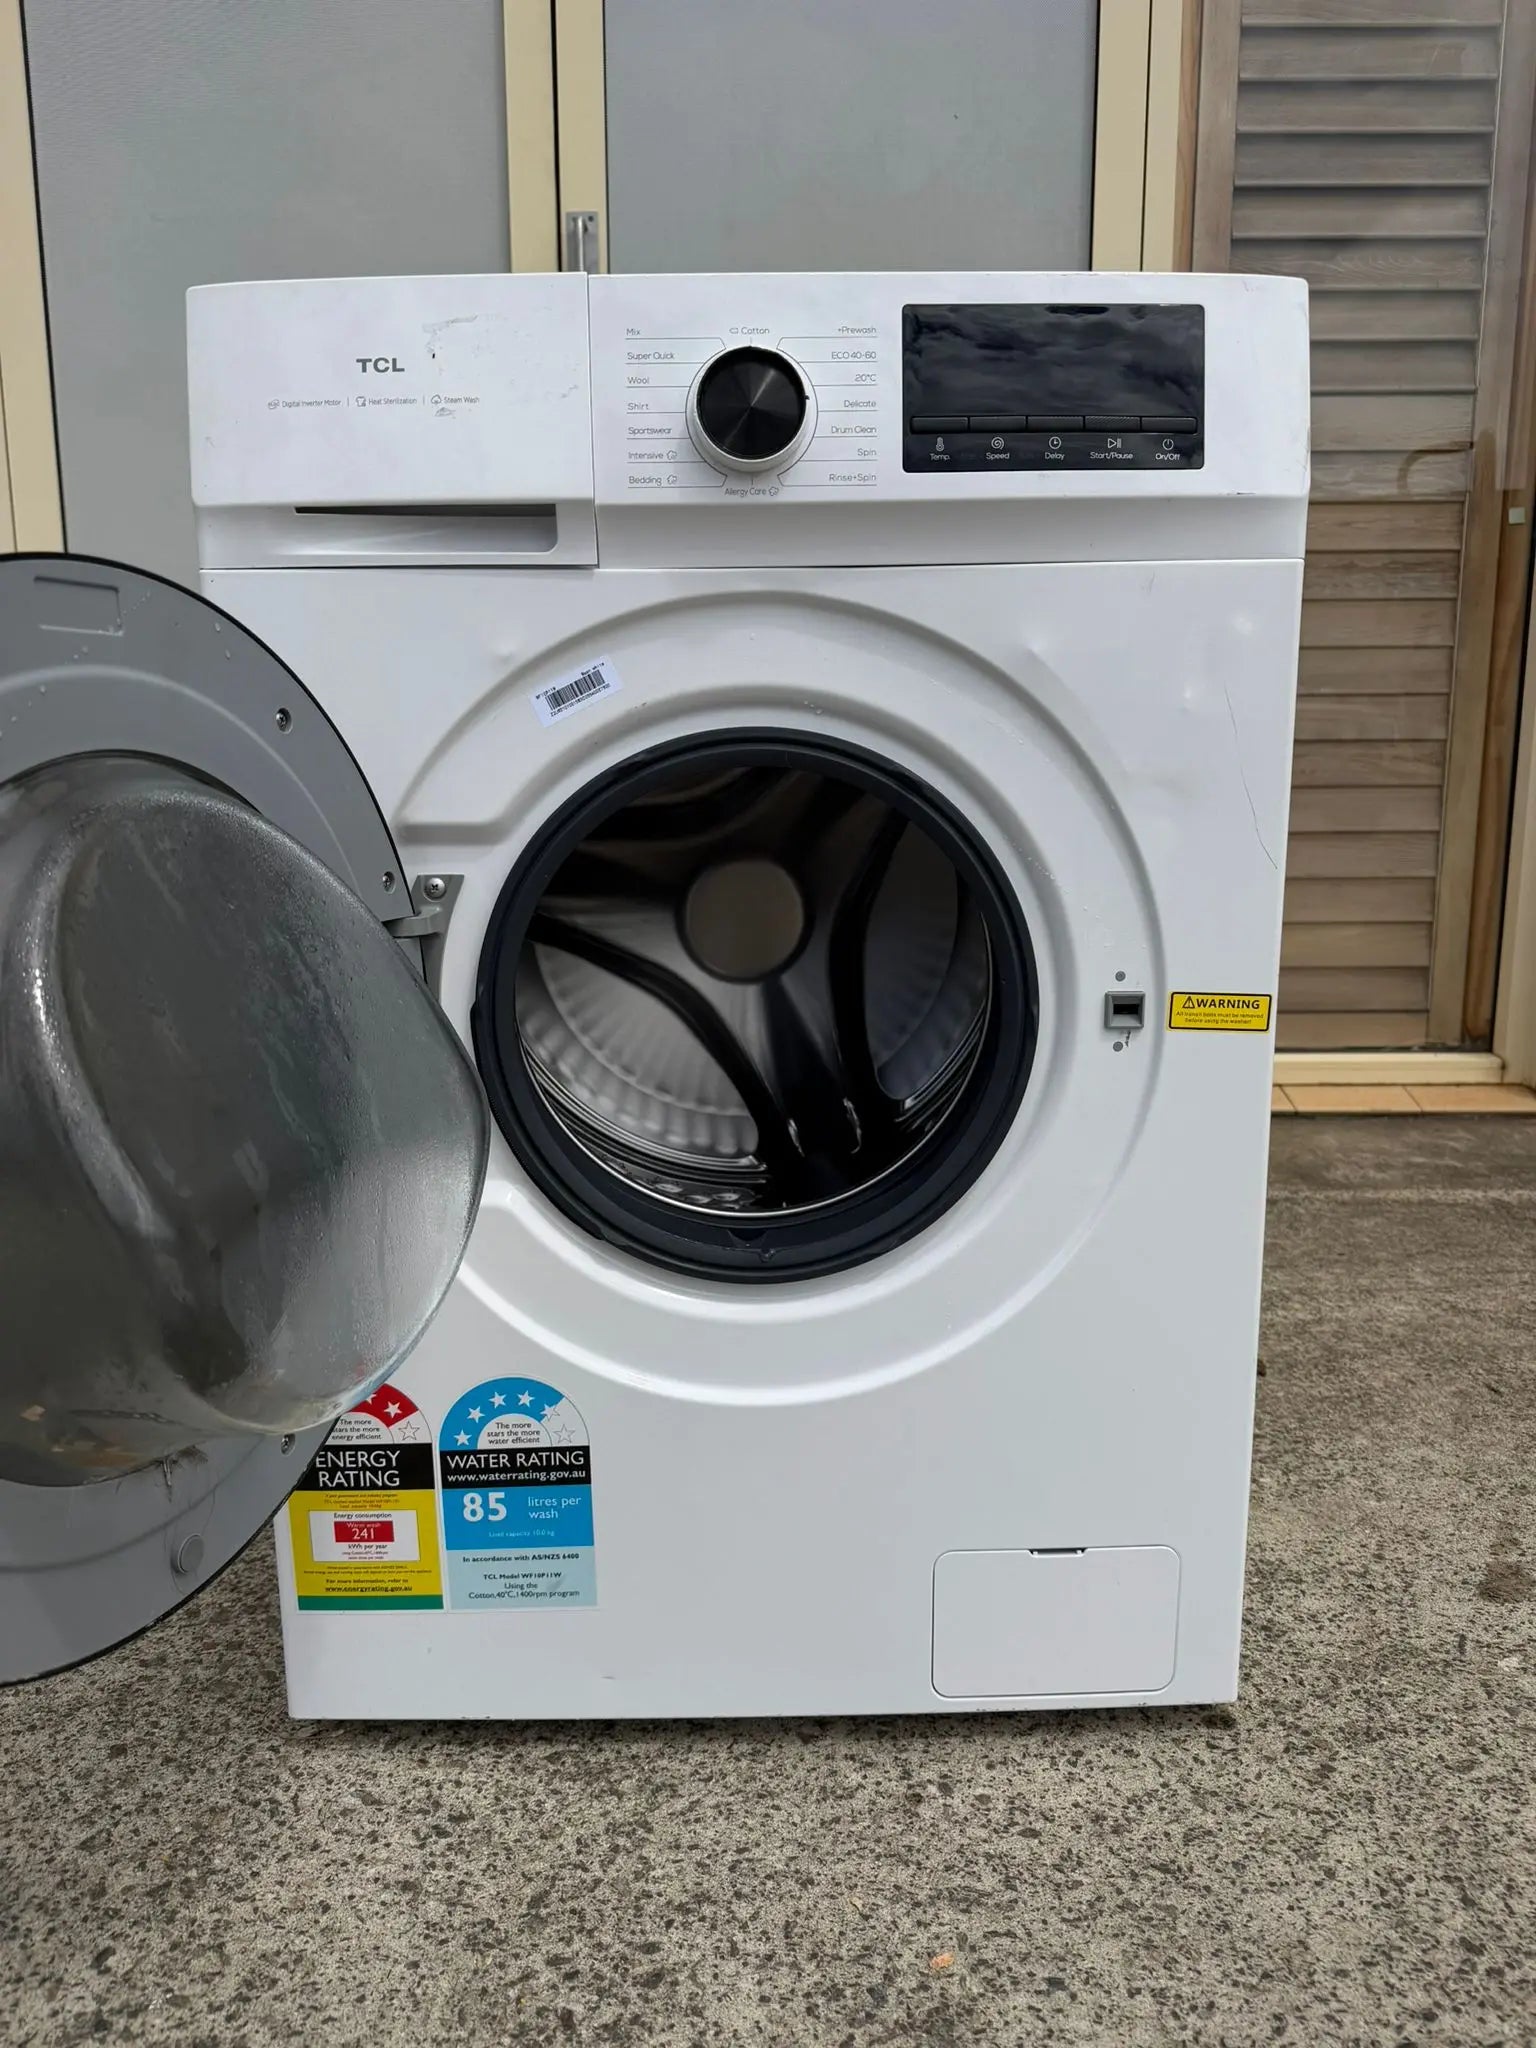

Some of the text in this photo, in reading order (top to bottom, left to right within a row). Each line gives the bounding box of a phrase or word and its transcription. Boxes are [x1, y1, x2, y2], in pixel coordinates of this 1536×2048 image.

[626, 328, 641, 336] Mix
[741, 327, 770, 335] Cotton
[838, 326, 877, 334] +Prewash
[627, 352, 675, 361] Super Quick
[831, 352, 877, 360] ECO 40-60
[356, 357, 405, 373] TCL
[628, 377, 650, 385] Wool
[855, 374, 877, 382] 20°C
[282, 400, 301, 409] Digital
[301, 399, 323, 407] Inverter
[444, 396, 480, 404] Steam Wash
[844, 400, 877, 408] Delicate
[628, 402, 650, 410] Shirt
[628, 427, 673, 436] Sportswear
[831, 425, 877, 434] Drum Clean
[628, 451, 664, 459] Intensive
[857, 448, 877, 457] Spin
[986, 452, 1010, 461] Speed
[1044, 452, 1065, 461] Delay
[1090, 451, 1133, 460] Start/Pause
[1155, 453, 1181, 461] On/Off
[629, 476, 662, 486] Bedding
[829, 473, 877, 483] Rinse+Spin
[725, 488, 767, 497] Allergy Care
[1196, 998, 1260, 1010] WARNING
[511, 1436, 540, 1444] efficient
[316, 1450, 400, 1468] ENERGY
[447, 1450, 584, 1469] WATER RATING
[318, 1470, 400, 1488] RATING
[447, 1469, 586, 1482] www.waterrating.gov.au
[463, 1491, 507, 1522] 85
[528, 1496, 581, 1509] litres per
[528, 1509, 558, 1519] wash
[352, 1527, 375, 1540] 241
[504, 1583, 525, 1591] Using
[549, 1590, 580, 1599] program
